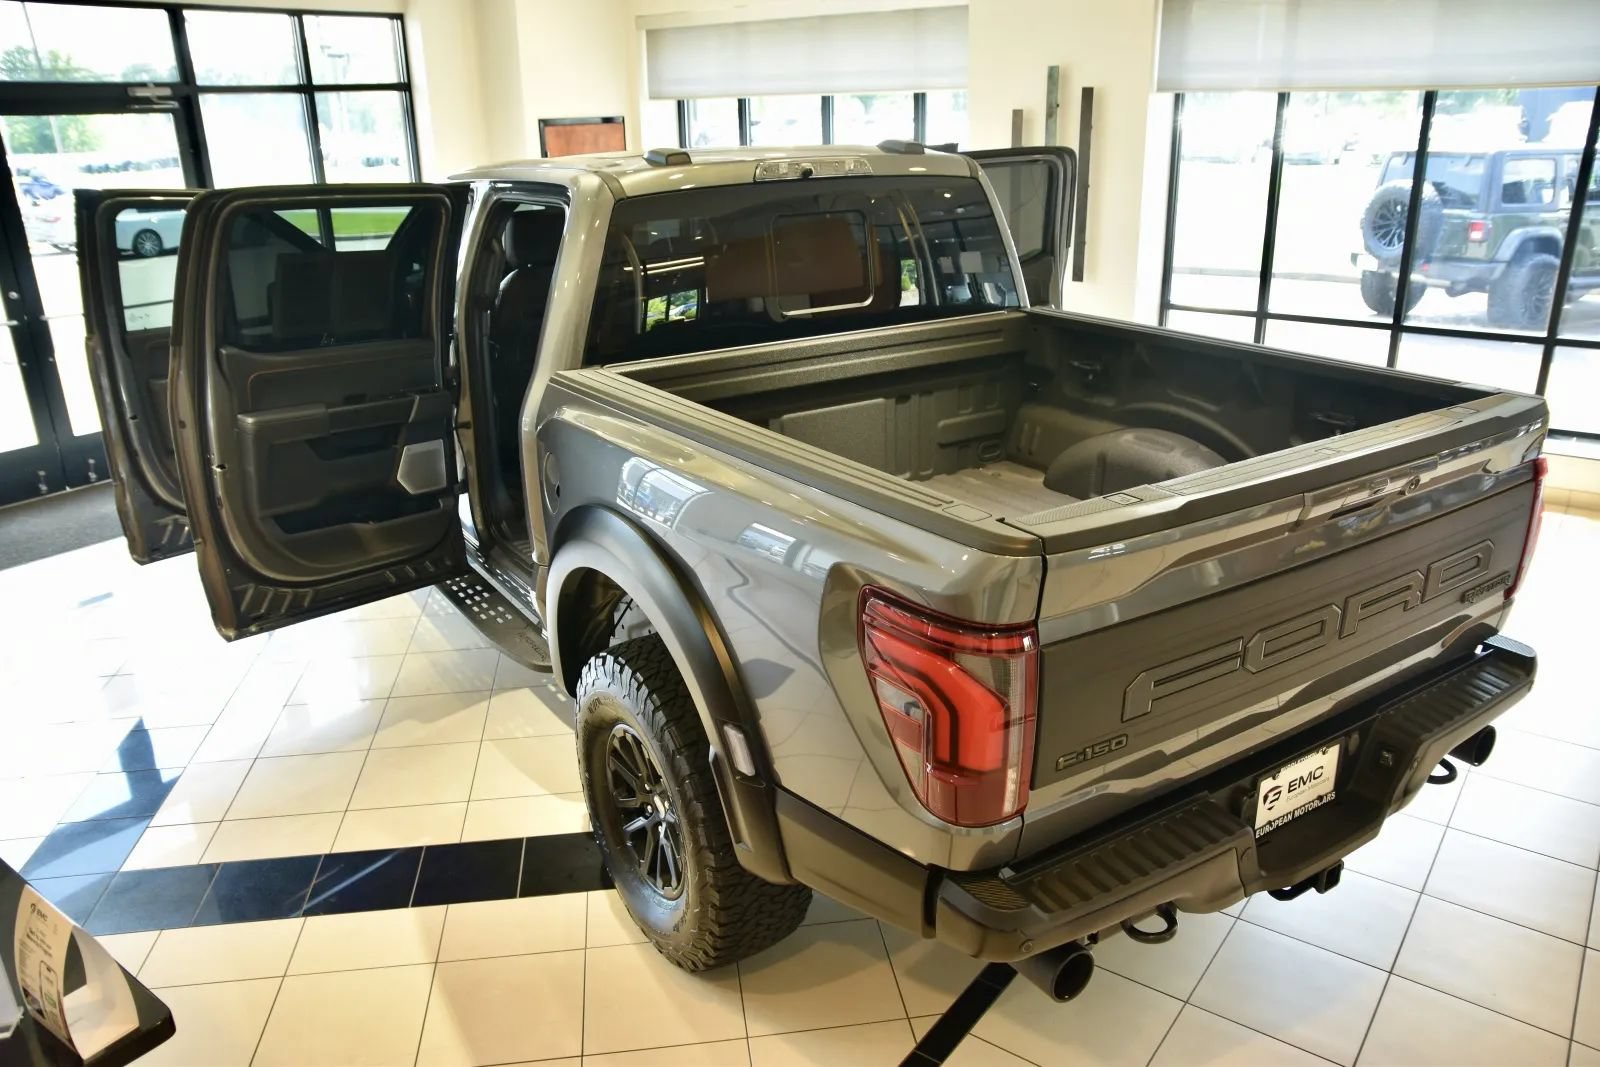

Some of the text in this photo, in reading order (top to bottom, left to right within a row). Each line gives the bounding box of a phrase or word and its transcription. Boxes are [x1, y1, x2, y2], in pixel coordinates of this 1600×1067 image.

[1121, 538, 1495, 723] FORD
[1056, 733, 1128, 772] F-150
[1287, 765, 1324, 793] EMC
[1255, 810, 1293, 839] EUROPEAN
